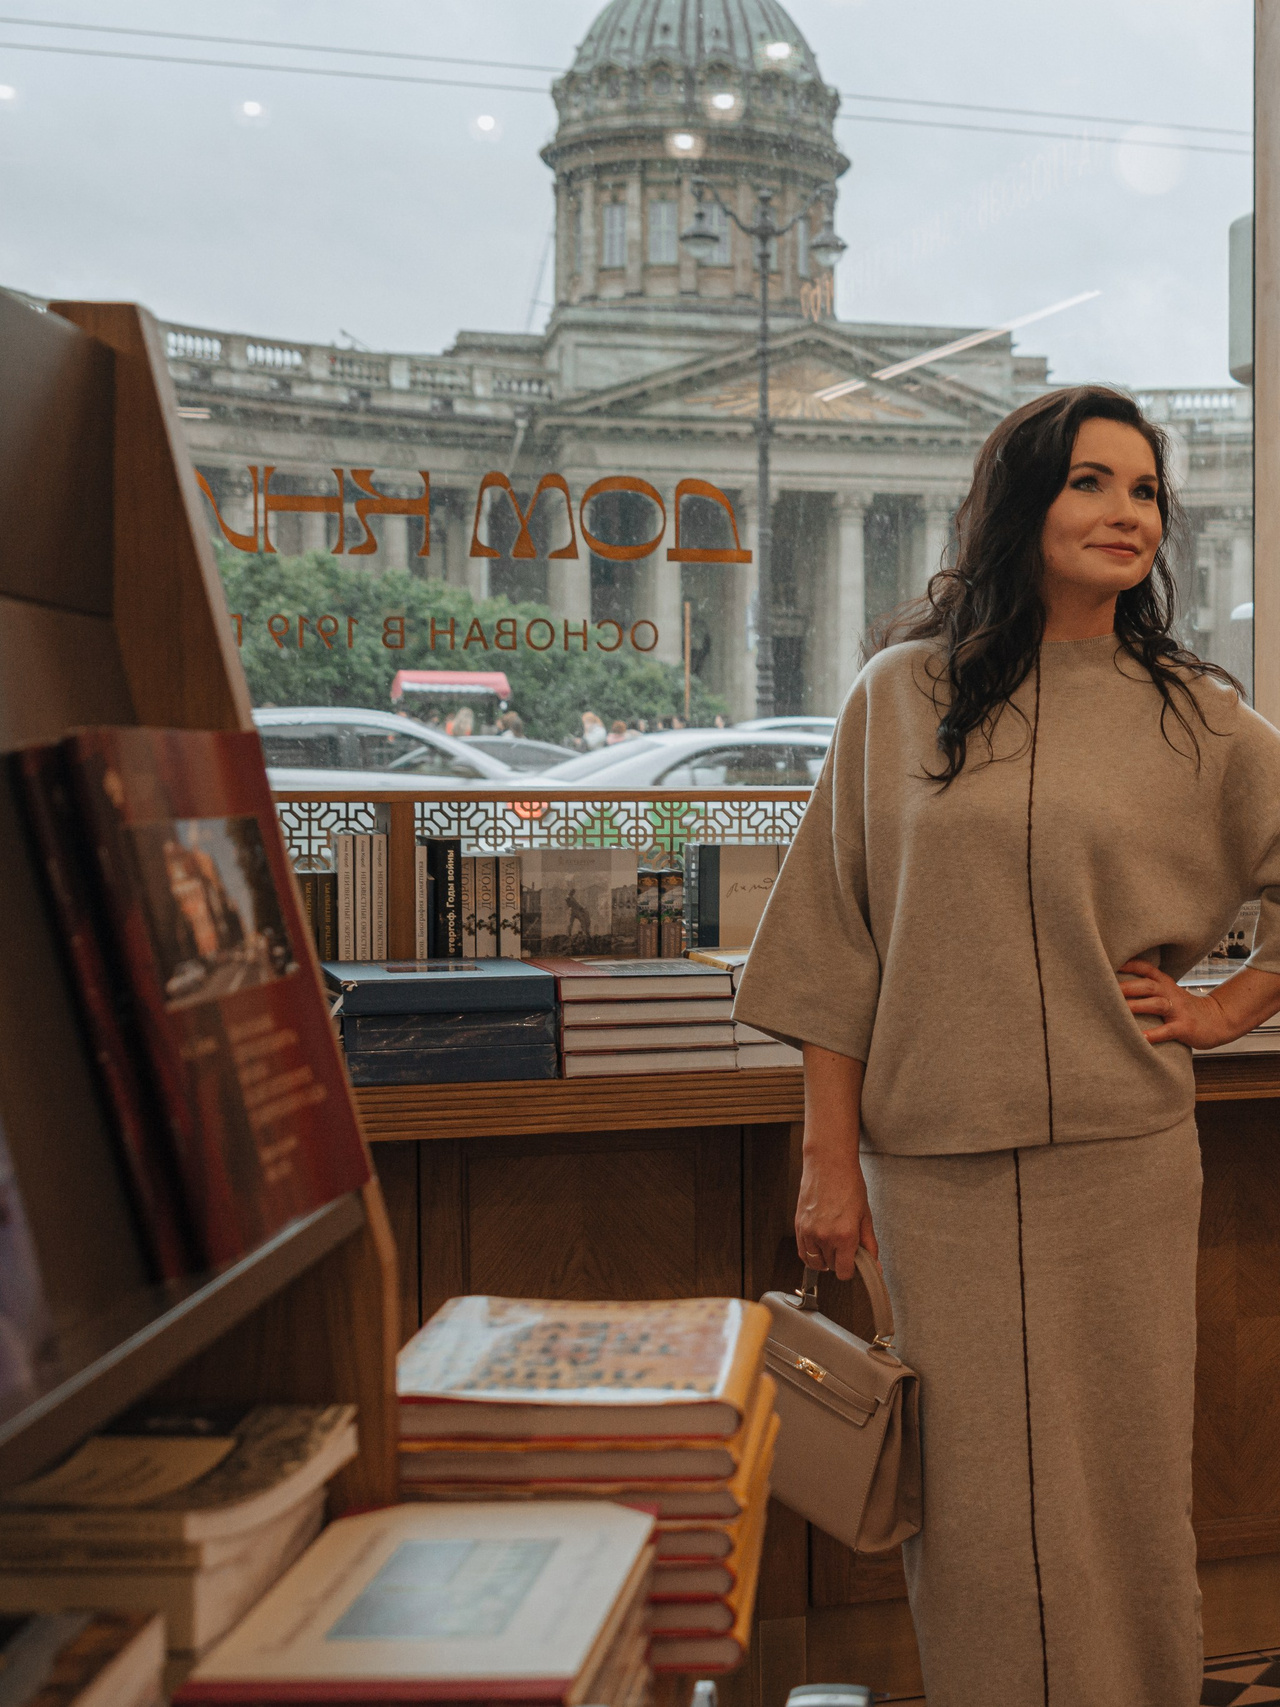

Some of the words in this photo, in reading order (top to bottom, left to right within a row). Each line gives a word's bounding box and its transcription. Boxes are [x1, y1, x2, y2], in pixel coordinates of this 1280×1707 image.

[446, 849, 456, 881] войны
[481, 861, 492, 910] ДОРОГА
[505, 861, 516, 910] ДОРОГА
[446, 883, 457, 908] Годы
[418, 900, 426, 938] Биография
[446, 909, 457, 956] етергоф.
